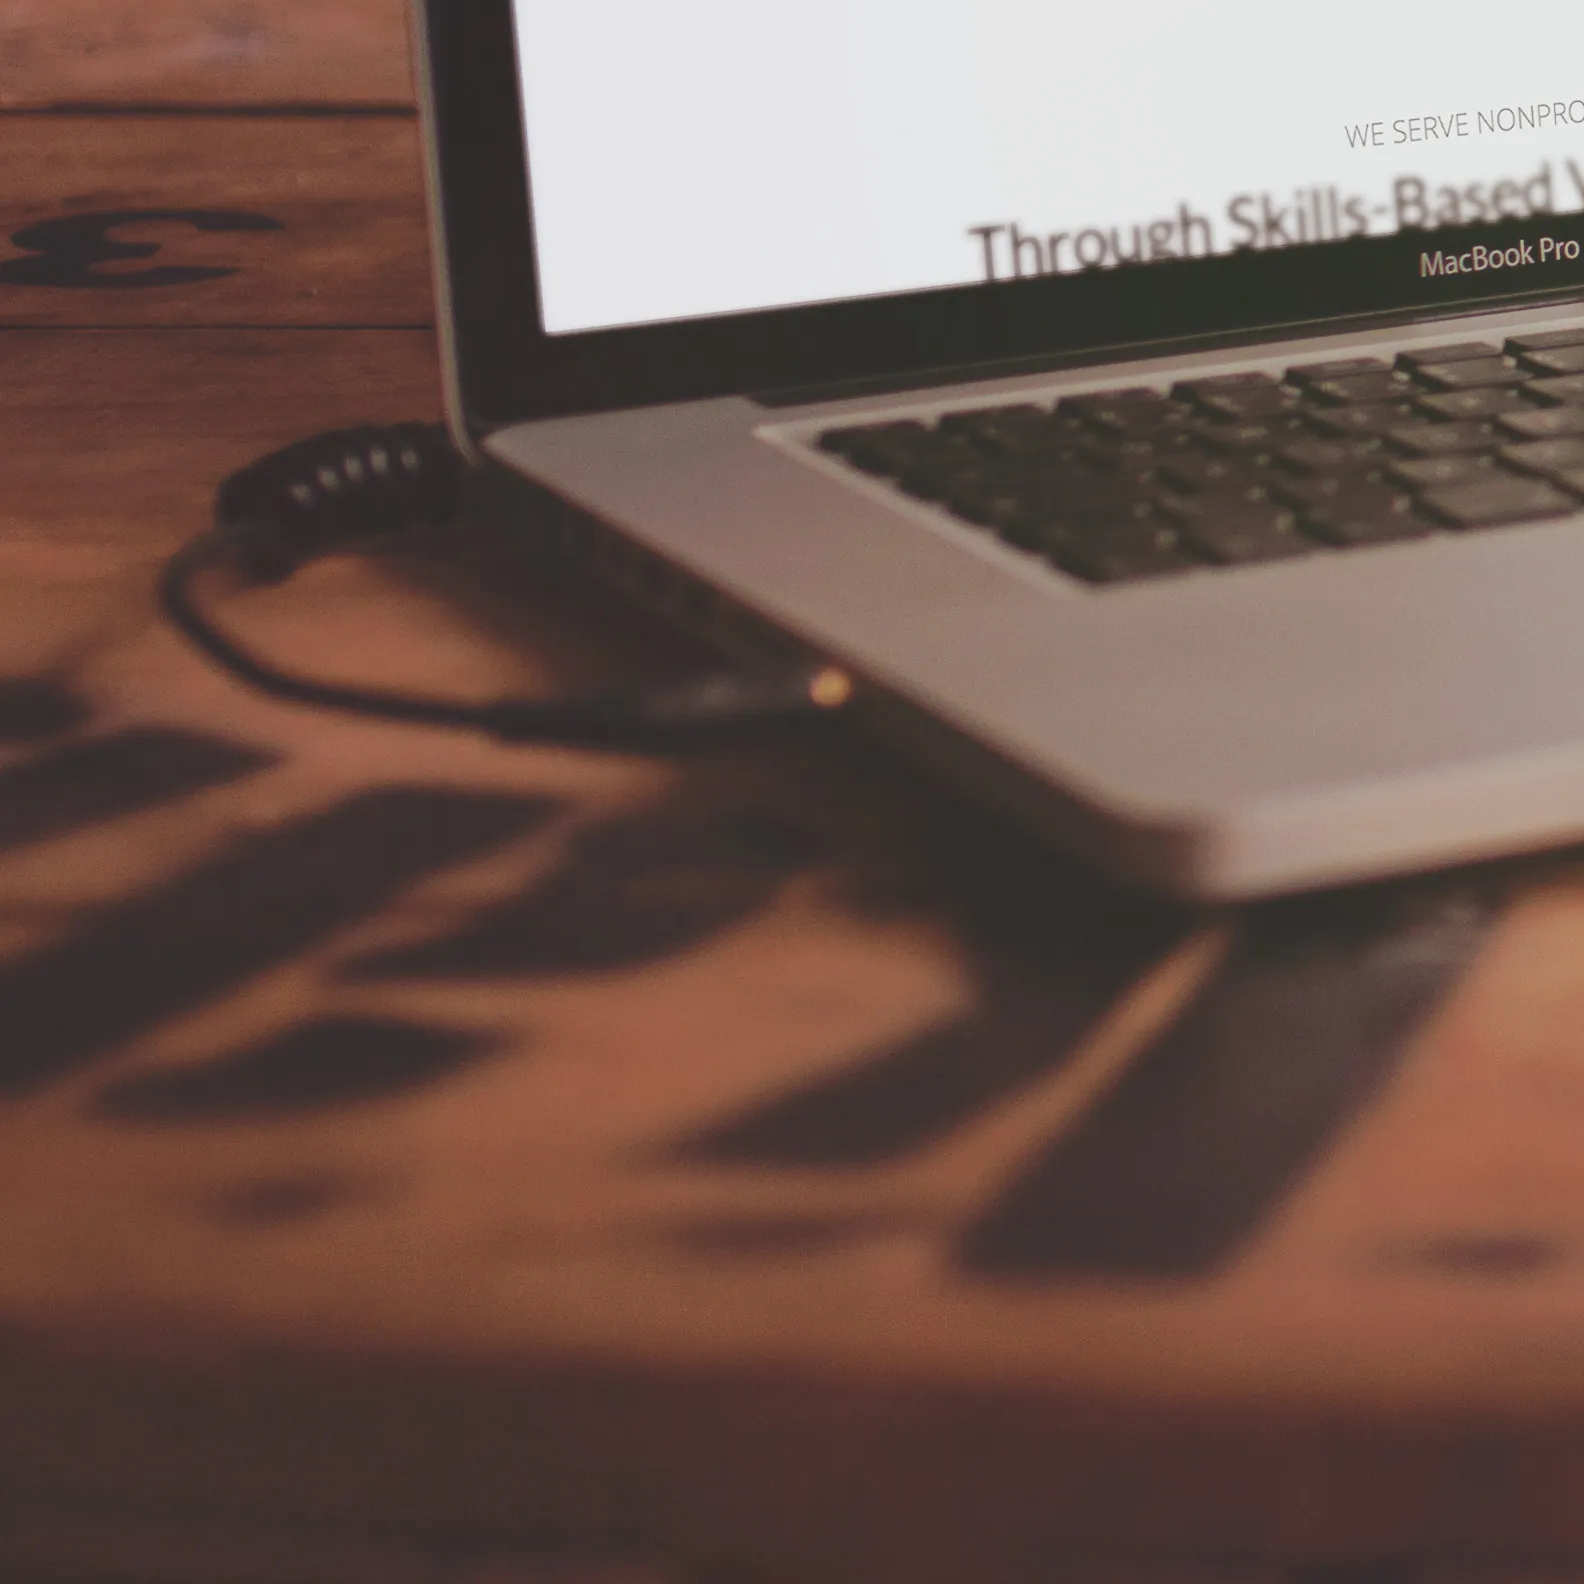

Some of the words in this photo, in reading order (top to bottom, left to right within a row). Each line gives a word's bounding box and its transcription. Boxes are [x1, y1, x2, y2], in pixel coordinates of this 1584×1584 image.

[1345, 122, 1384, 148] WE
[1393, 113, 1468, 143] SERVE
[968, 198, 1213, 282] Through
[1227, 158, 1552, 254] Skills-Based
[1421, 239, 1534, 277] MacBook
[1540, 237, 1580, 262] Pro
